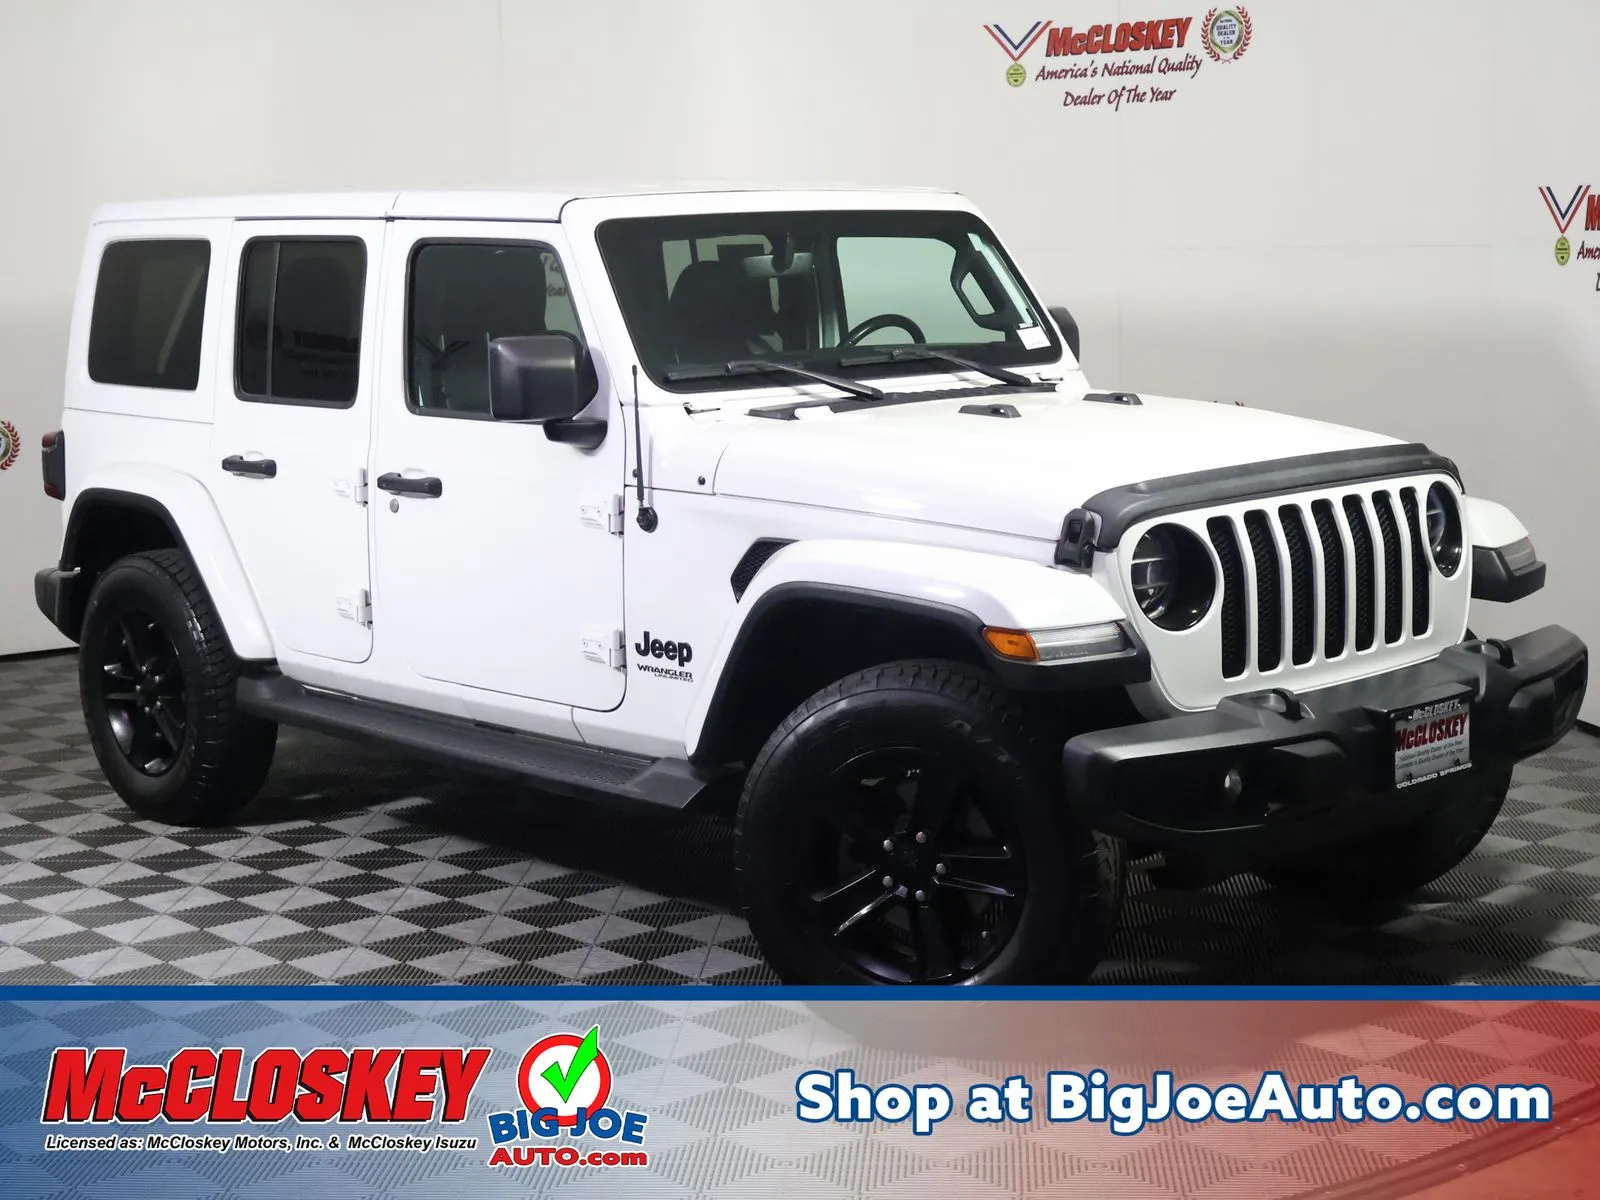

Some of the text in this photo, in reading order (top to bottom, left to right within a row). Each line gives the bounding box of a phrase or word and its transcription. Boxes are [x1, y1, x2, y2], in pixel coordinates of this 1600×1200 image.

[1045, 17, 1192, 57] McCLOSKEY
[1035, 60, 1098, 81] America's
[1101, 55, 1157, 78] National
[1158, 52, 1203, 79] Quality
[1063, 84, 1177, 112] Dealer Of The Year
[635, 631, 692, 667] Jeep
[637, 663, 693, 679] WRANGLER
[1397, 711, 1468, 752] McCLOSKEY
[1439, 762, 1473, 776] SPRINGS
